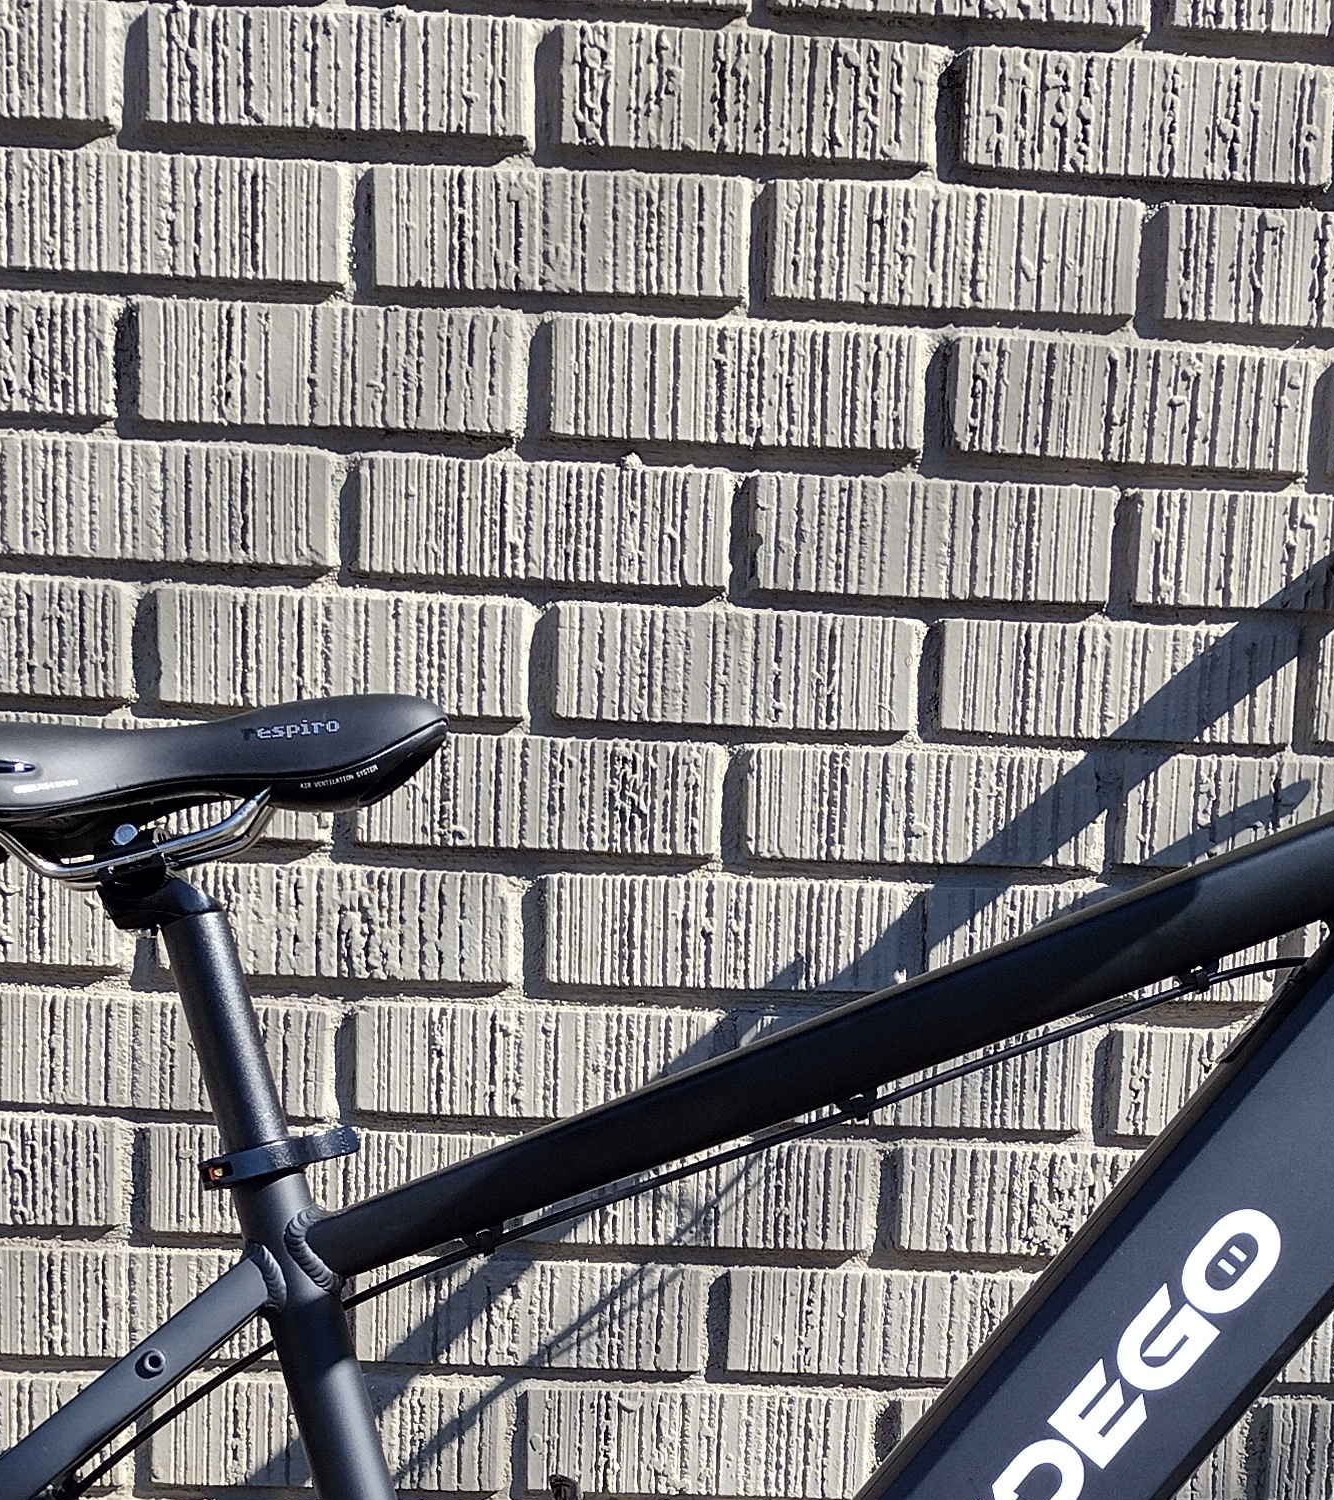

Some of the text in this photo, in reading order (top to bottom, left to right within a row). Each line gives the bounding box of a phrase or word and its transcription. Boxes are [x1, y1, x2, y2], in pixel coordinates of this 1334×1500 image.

[242, 718, 341, 742] respiro
[300, 763, 380, 790] AIR VENTILATION SYSTEM
